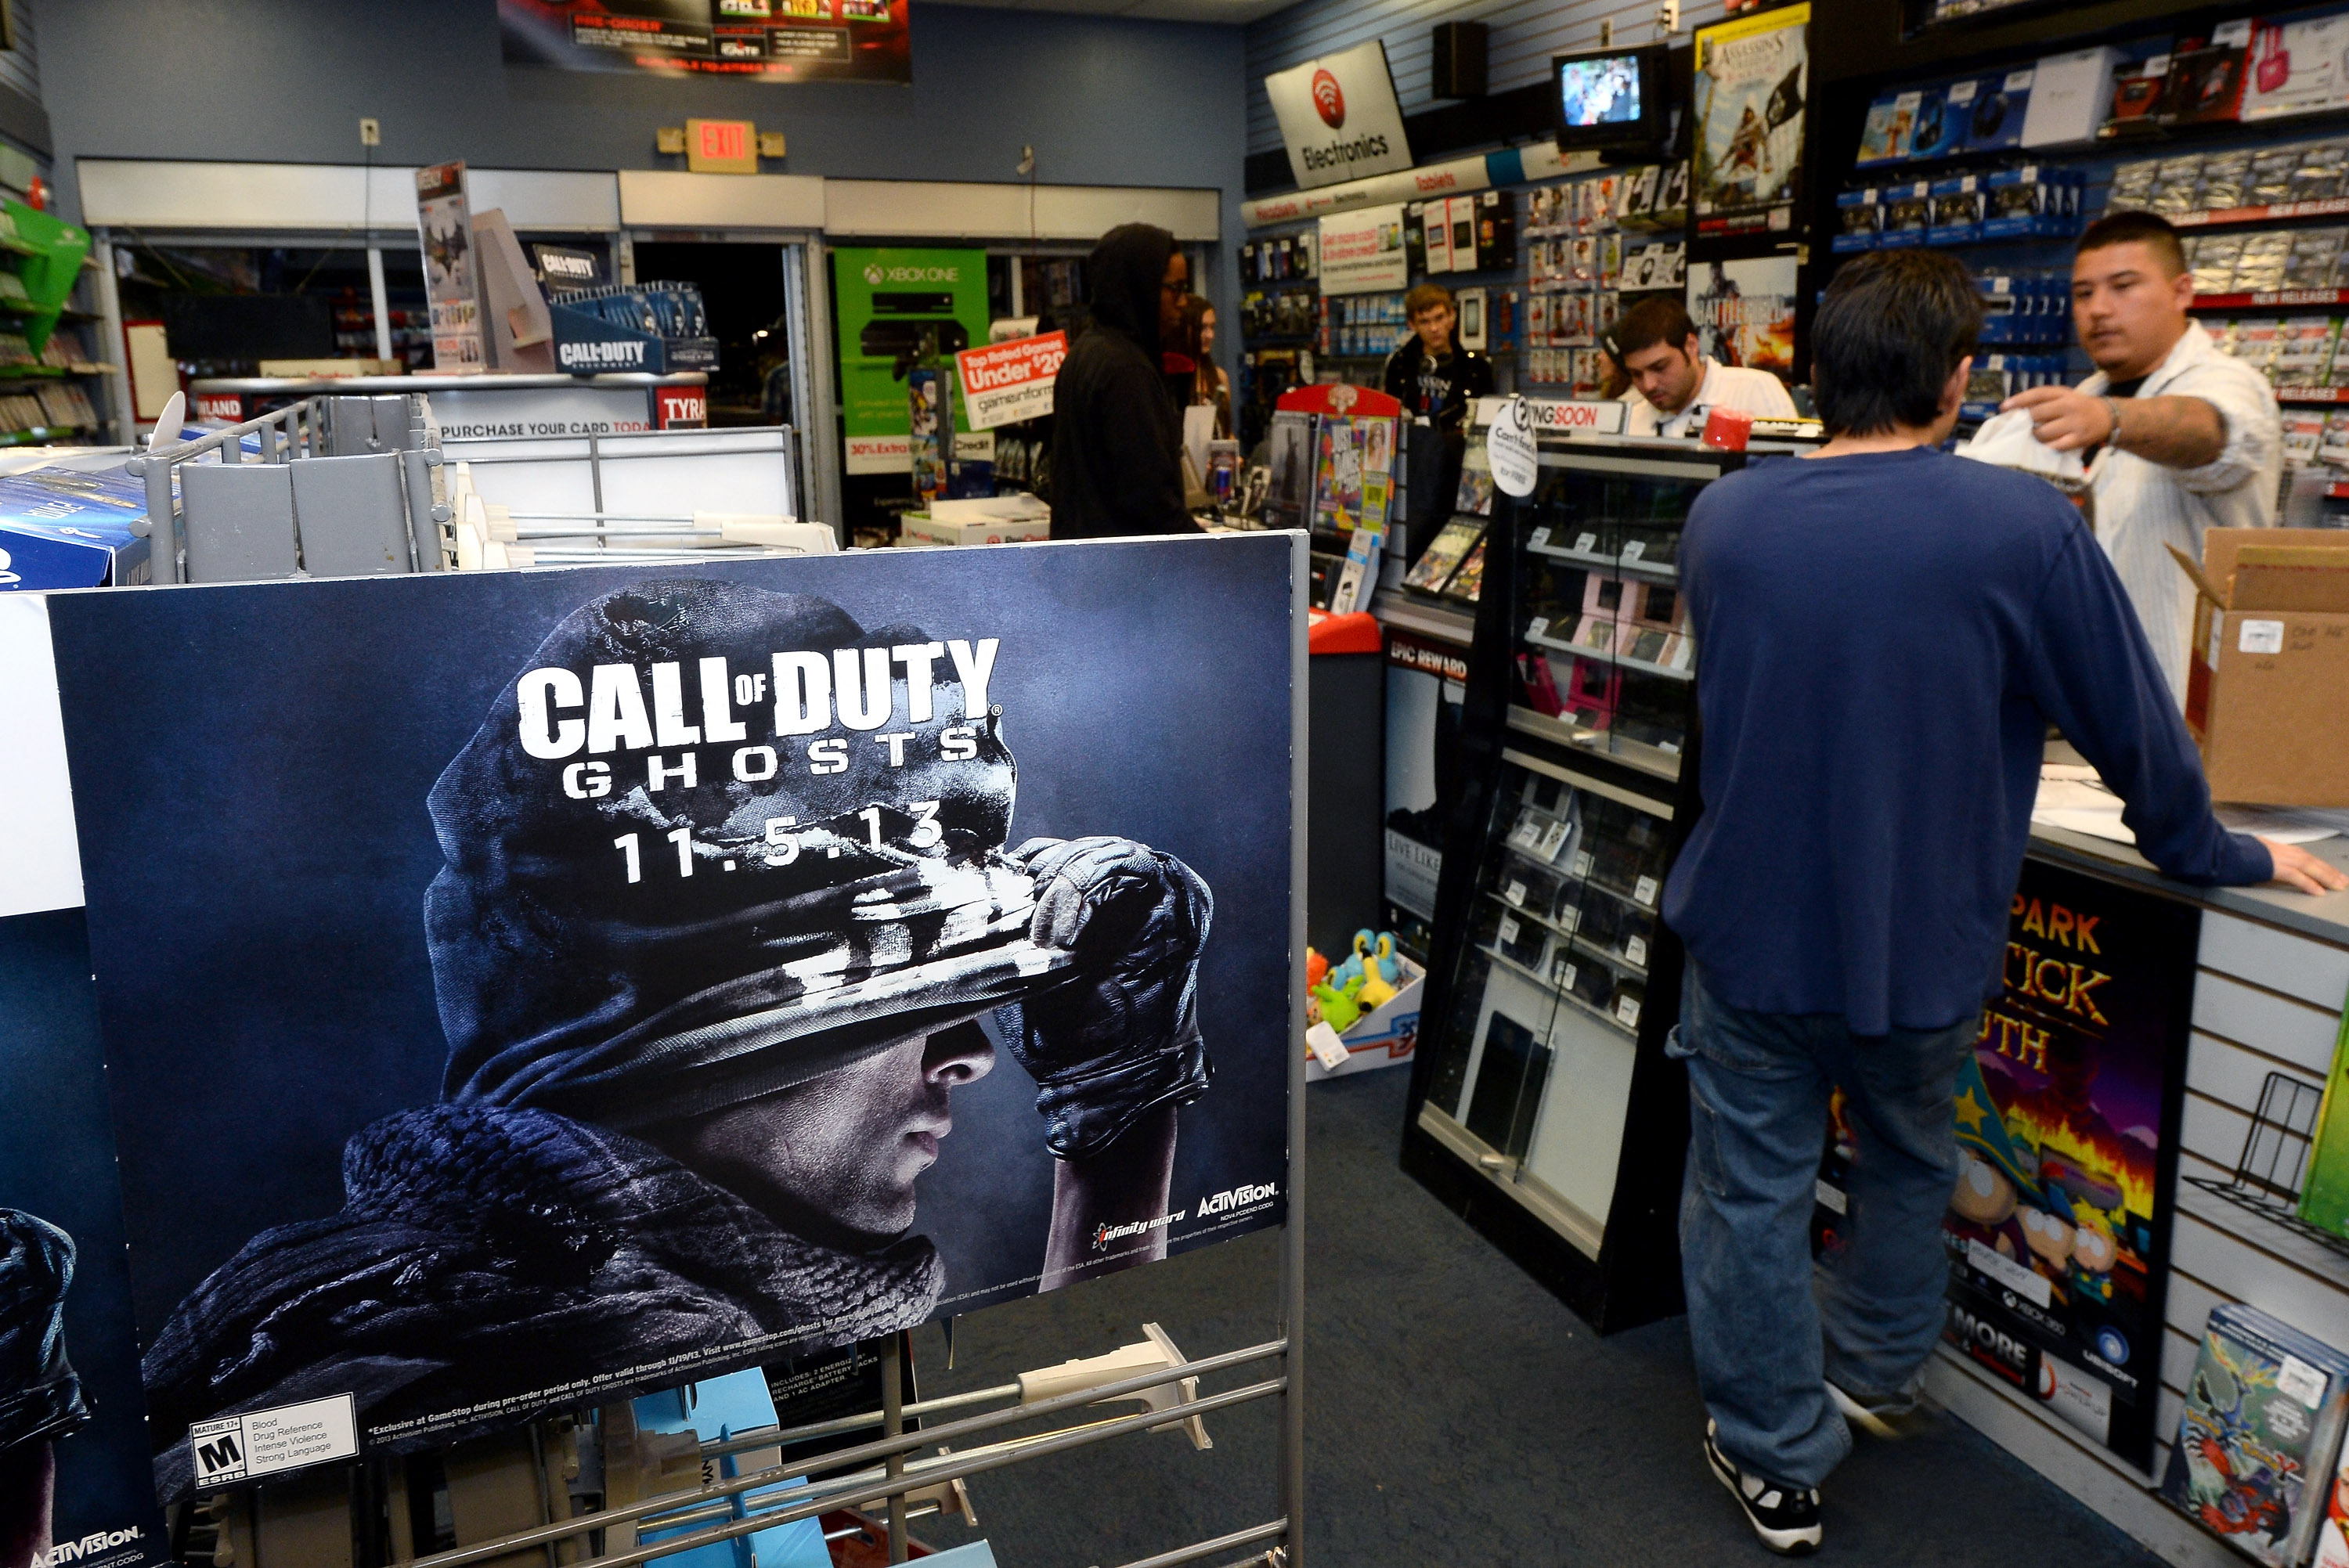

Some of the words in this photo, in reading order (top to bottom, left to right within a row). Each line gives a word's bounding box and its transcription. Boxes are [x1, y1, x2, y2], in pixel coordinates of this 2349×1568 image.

[699, 122, 746, 160] EXIT
[1301, 132, 1389, 171] Electronics
[1416, 172, 1456, 193] Tablets
[887, 267, 926, 282] XBOX
[927, 267, 959, 282] ONE
[2252, 292, 2279, 305] NEW
[2281, 290, 2339, 303] RELEASES
[560, 343, 597, 366] CALL
[601, 341, 645, 362] DUTY
[965, 355, 988, 369] Top
[987, 347, 1023, 363] Rated
[1022, 340, 1063, 357] Games
[968, 361, 1032, 390] Under
[1032, 350, 1066, 374] $20
[2280, 387, 2338, 401] RELEASES
[441, 423, 524, 438] PURCHASE
[529, 423, 566, 435] YOUR
[570, 422, 609, 434] CARD
[876, 443, 909, 455] Extra
[955, 439, 990, 452] Credit
[1391, 640, 1416, 664] EPIC
[1417, 648, 1467, 679] REWARD
[517, 655, 747, 759] CALL
[734, 672, 767, 706] OF
[771, 637, 1001, 737] DUTY
[561, 726, 980, 800] GHOSTS
[613, 800, 944, 885] 11.5.13
[2010, 892, 2102, 955] PARK
[1197, 1182, 1276, 1218] ACTIVISION
[957, 1292, 970, 1302] (ESA)
[980, 1288, 990, 1296] may
[1006, 1280, 1018, 1289] used
[1019, 1275, 1036, 1285] without
[1076, 1262, 1086, 1271] ESA.
[1093, 1257, 1105, 1266] other
[1105, 1250, 1131, 1263] trademarks
[1131, 1247, 1139, 1256] and
[1139, 1244, 1151, 1253] trade
[1181, 1229, 1202, 1242] properties
[1207, 1225, 1218, 1234] their
[1218, 1220, 1238, 1232] respective
[1238, 1216, 1254, 1225] owners.
[1954, 1306, 2028, 1372] MORE
[416, 1416, 427, 1426] at
[428, 1407, 471, 1423] GameStop
[473, 1399, 501, 1413] during
[503, 1390, 542, 1408] pre-order
[543, 1382, 570, 1397] period
[572, 1378, 591, 1390] only.
[593, 1372, 613, 1385] Offer
[615, 1367, 634, 1379] valid
[635, 1359, 666, 1374] through
[668, 1350, 702, 1365] 11/19/13.
[703, 1345, 722, 1357] Visit
[723, 1319, 821, 1352] www.gamestop.com/ghosts
[822, 1317, 834, 1328] for
[770, 1371, 811, 1388] INCLUDES:
[820, 1354, 863, 1373] ENERGIZR
[772, 1379, 814, 1396] RECHARGE
[818, 1365, 852, 1381] BATTERY
[858, 1356, 879, 1368] ACKS
[2082, 1349, 2138, 1388] UBISOFT
[376, 1435, 392, 1445] 2013
[392, 1427, 423, 1441] Activision
[423, 1420, 457, 1435] Publishing,
[457, 1417, 470, 1426] Inc.
[470, 1409, 506, 1423] ACTIVISION,
[506, 1405, 521, 1414] CALL
[548, 1396, 561, 1404] and
[561, 1392, 576, 1401] CALL
[585, 1385, 601, 1395] DUTY
[601, 1379, 624, 1392] GHOSTS
[625, 1378, 634, 1386] are
[634, 1370, 667, 1383] trademarks
[674, 1361, 702, 1373] Activision
[702, 1354, 731, 1368] Publishing,
[732, 1350, 742, 1359] Inc.
[742, 1346, 757, 1356] ESRB
[757, 1343, 774, 1353] rating
[774, 1339, 788, 1348] icons
[798, 1329, 825, 1342] registered
[773, 1393, 790, 1403] AND
[810, 1375, 848, 1393] ADAPTER.
[195, 1422, 225, 1435] MATURE
[226, 1420, 238, 1429] 17+
[252, 1418, 278, 1431] Blood
[254, 1431, 275, 1443] Drug
[277, 1420, 323, 1437] Reference
[254, 1439, 287, 1454] Intense
[289, 1431, 327, 1447] Violence
[197, 1434, 242, 1474] M
[256, 1449, 285, 1465] Strong
[287, 1441, 331, 1459] Language
[198, 1470, 247, 1487] ESRB
[30, 1525, 140, 1568] ACTIVISION
